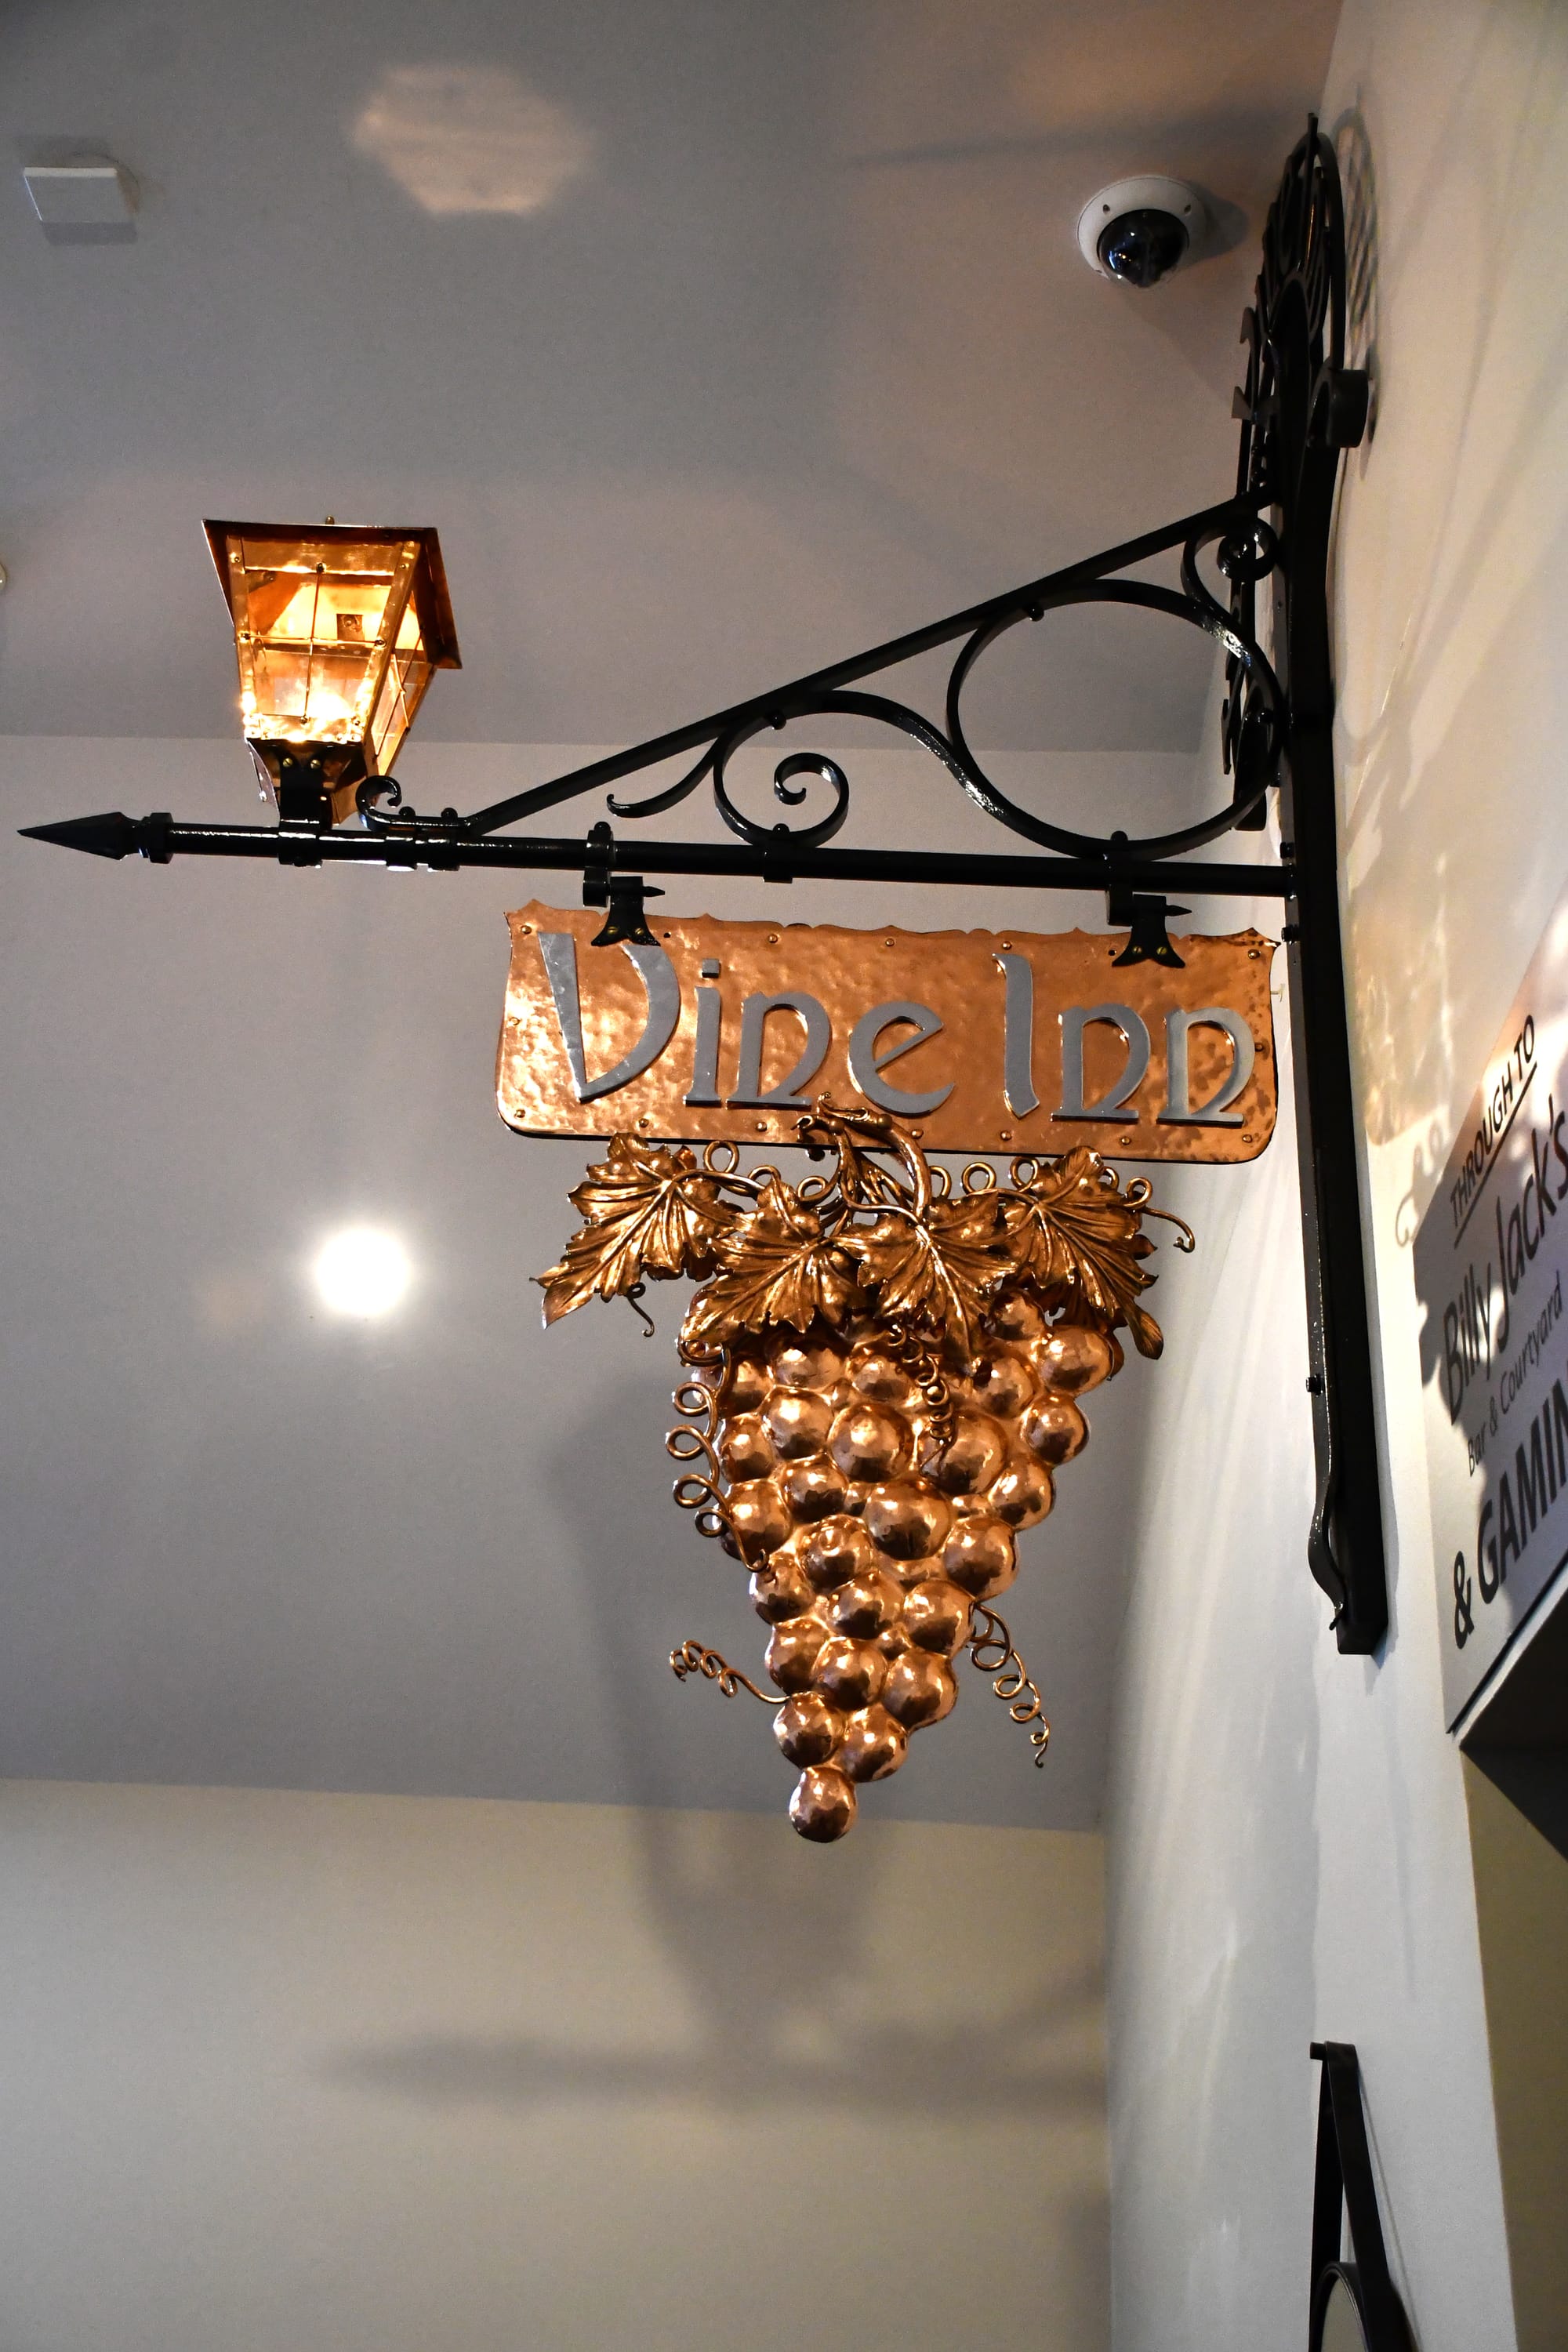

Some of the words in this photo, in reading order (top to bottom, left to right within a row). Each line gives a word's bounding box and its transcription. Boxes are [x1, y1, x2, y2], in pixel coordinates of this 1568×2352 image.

[538, 932, 955, 1118] Vine
[992, 953, 1256, 1127] Inn
[1450, 1061, 1513, 1229] THROUGH
[1514, 1014, 1535, 1080] TO
[1443, 1262, 1490, 1425] Billy
[1496, 1093, 1568, 1353] Jack's
[1468, 1421, 1486, 1477] Bar
[1490, 1396, 1498, 1437] &
[1501, 1269, 1563, 1414] Courtyard
[1454, 1550, 1475, 1650] &
